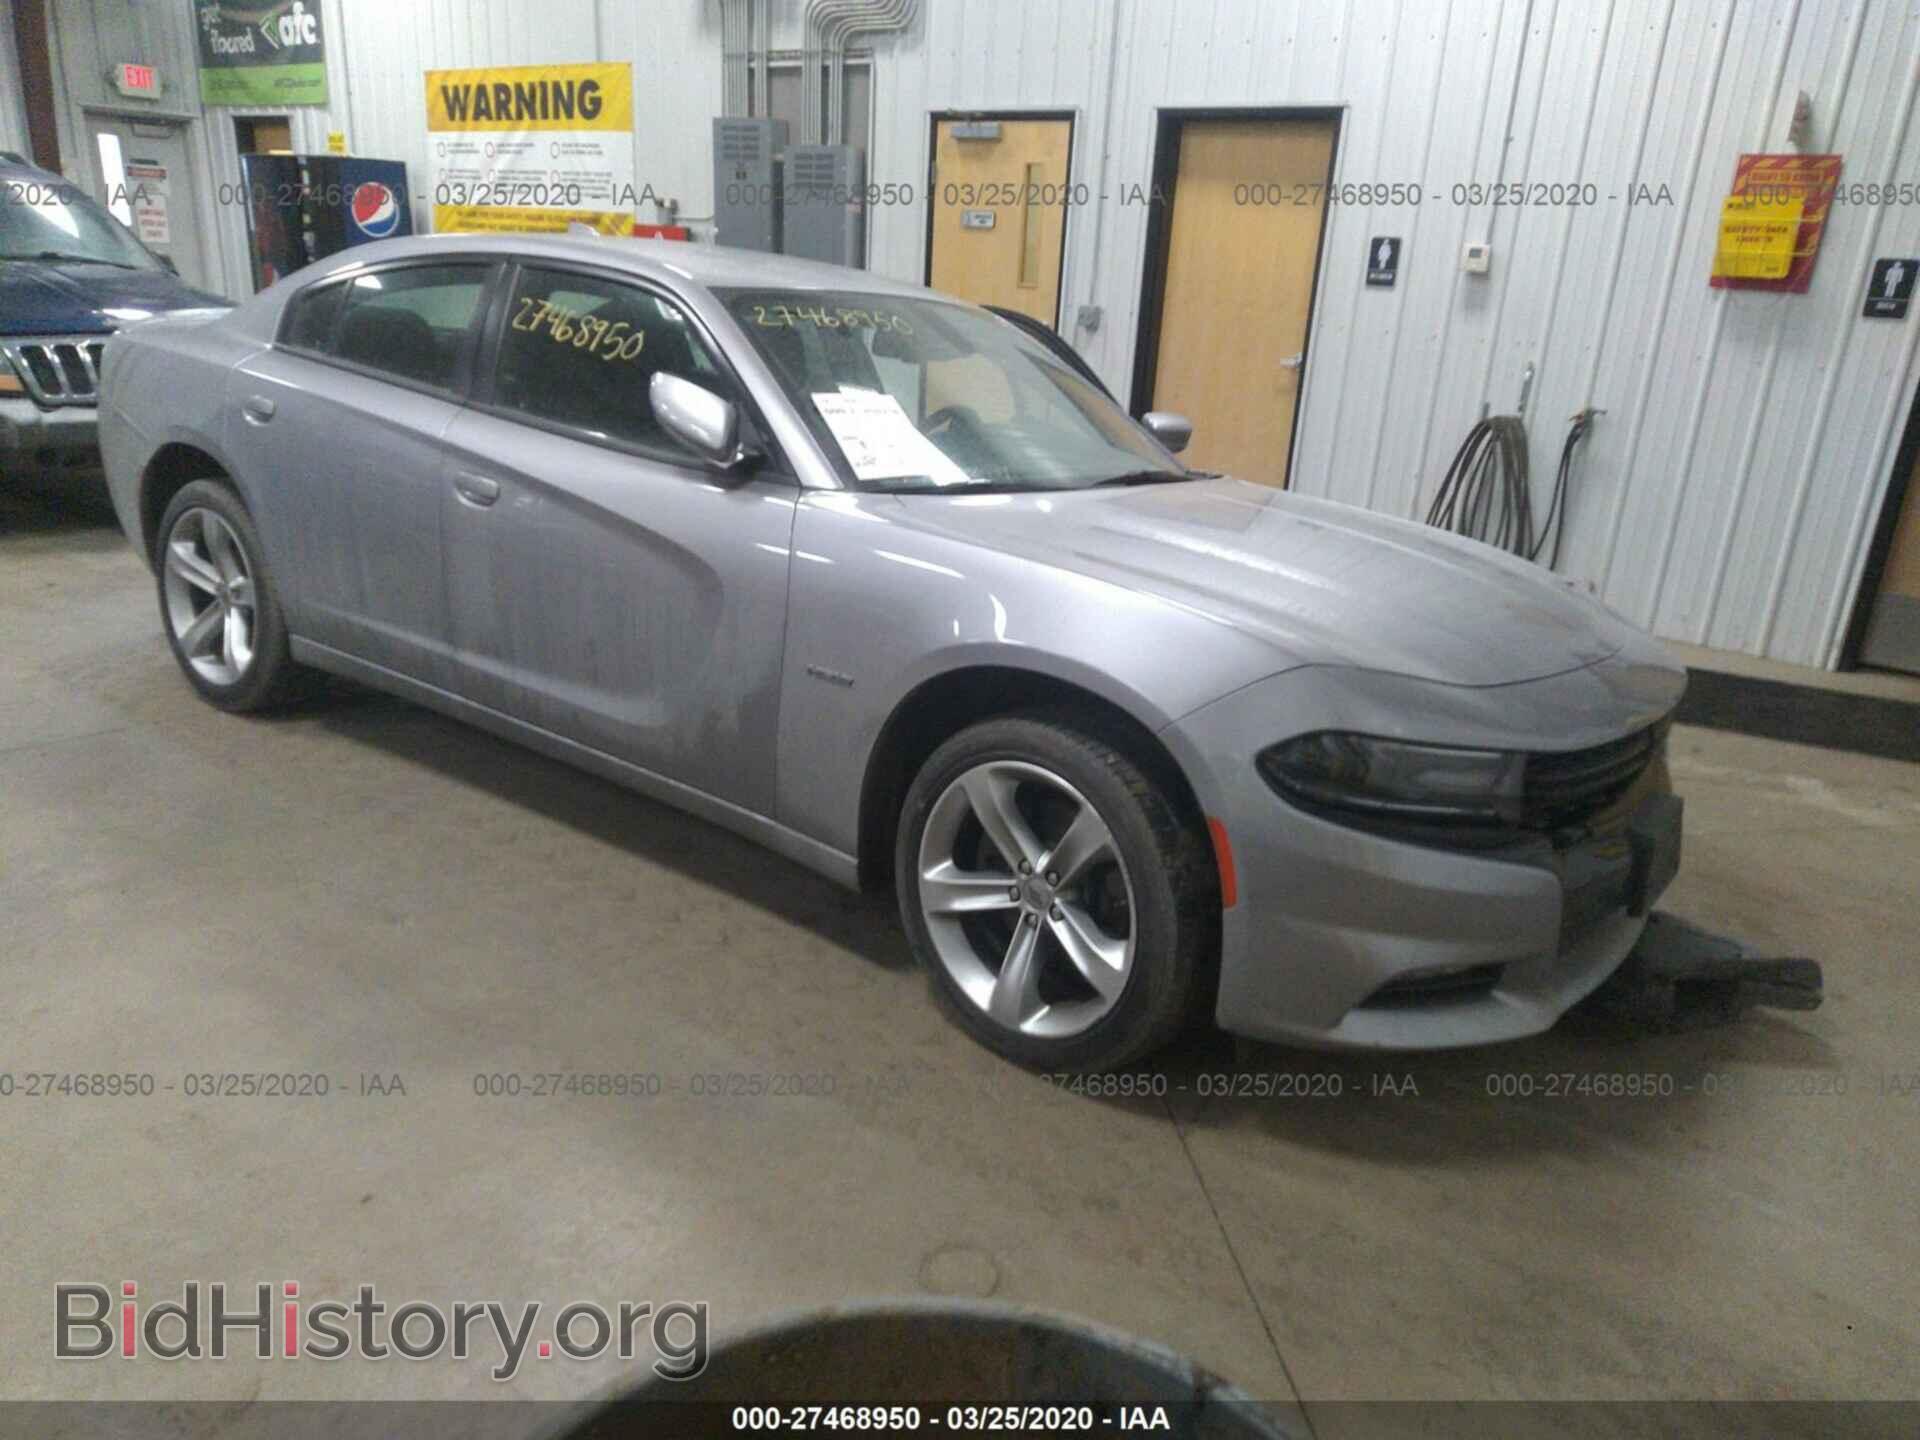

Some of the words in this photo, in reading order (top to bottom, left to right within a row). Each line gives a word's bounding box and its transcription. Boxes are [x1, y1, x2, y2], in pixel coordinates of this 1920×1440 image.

[279, 1, 317, 46] afc
[124, 64, 154, 88] EXIT
[441, 79, 603, 122] WARNING
[512, 297, 645, 361] 27468950
[753, 305, 914, 336] 27468950
